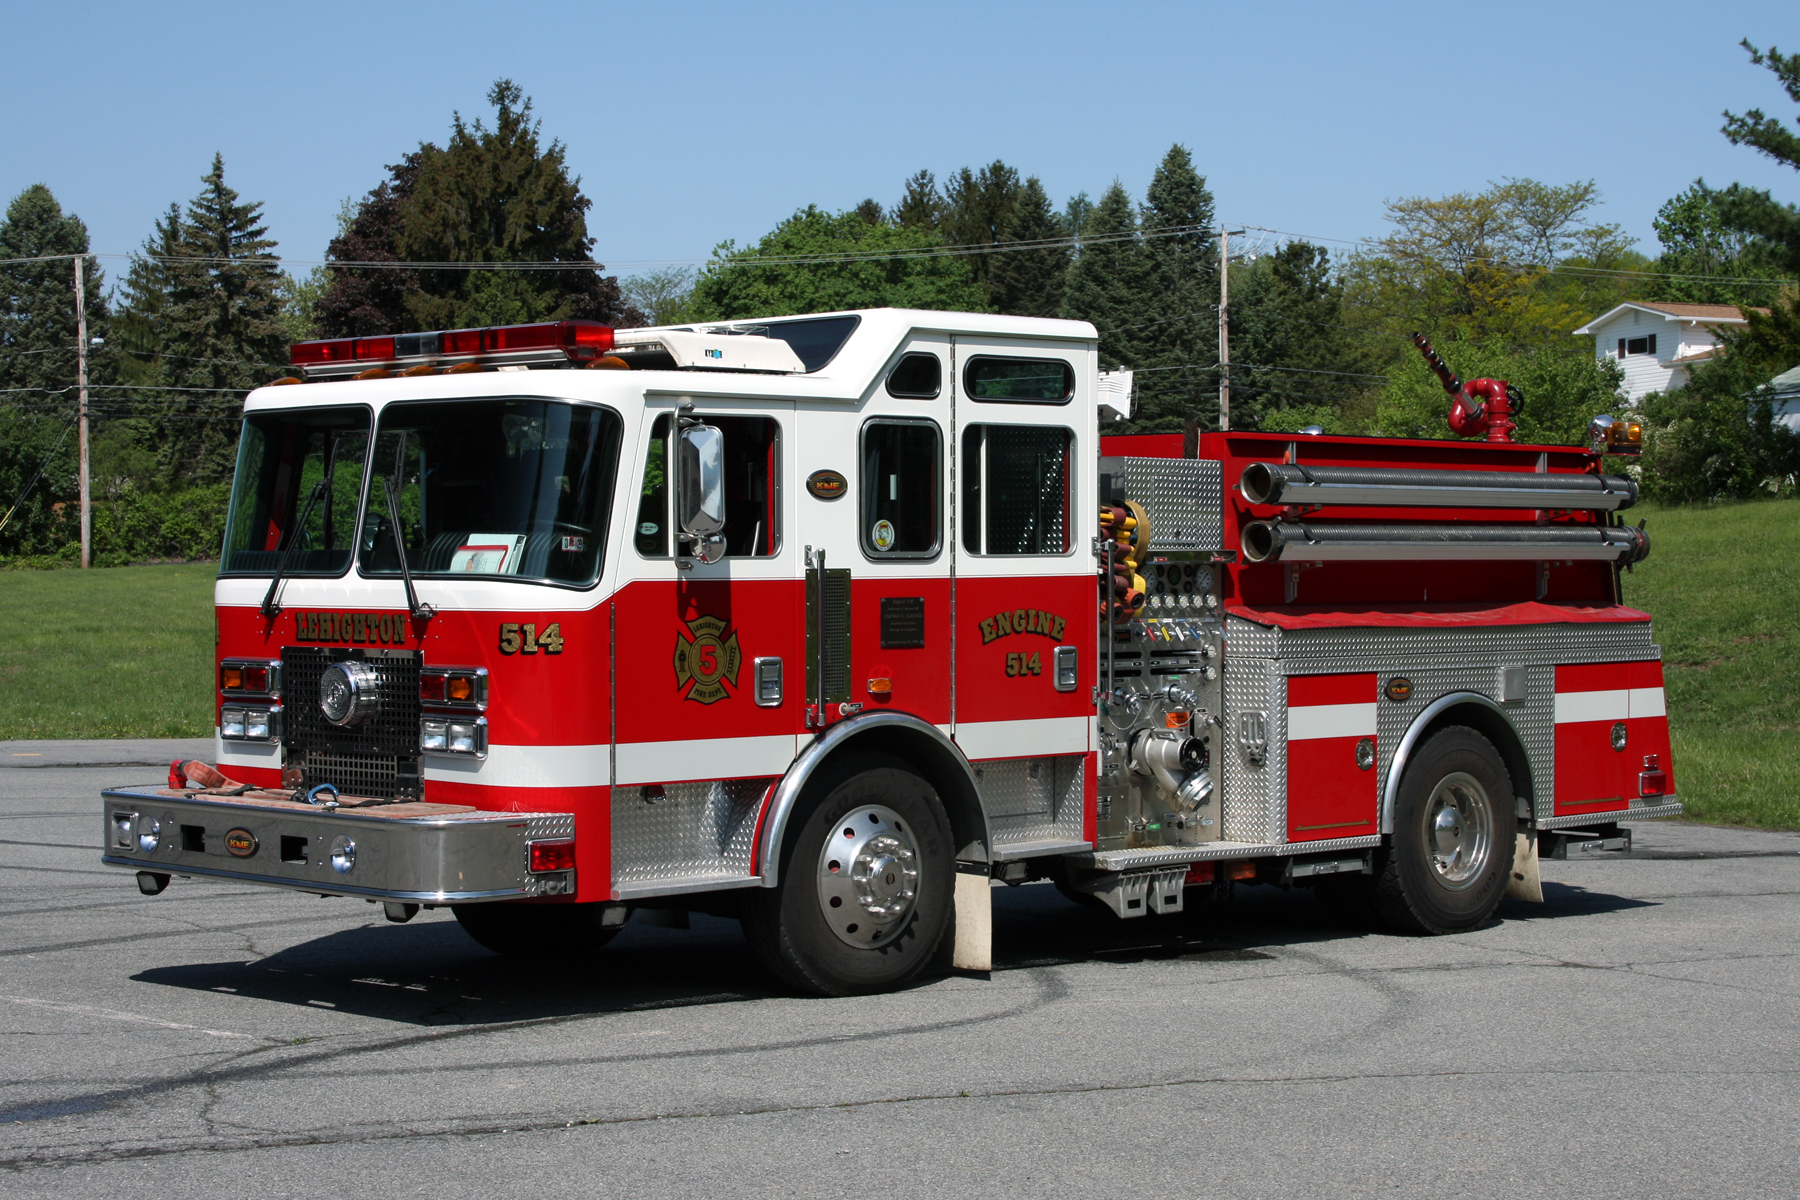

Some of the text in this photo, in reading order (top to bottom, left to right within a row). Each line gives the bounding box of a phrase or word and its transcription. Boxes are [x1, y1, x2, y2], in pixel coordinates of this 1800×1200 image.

[816, 481, 840, 491] KME
[295, 612, 406, 645] LEHIGHTON
[692, 621, 722, 633] LEHIGHTON
[979, 609, 1066, 645] ENGINE
[498, 623, 564, 656] 514
[698, 644, 718, 676] 5
[1005, 651, 1042, 678] 514
[693, 688, 707, 698] FIRE
[1391, 686, 1409, 694] KME
[229, 839, 250, 850] KME
